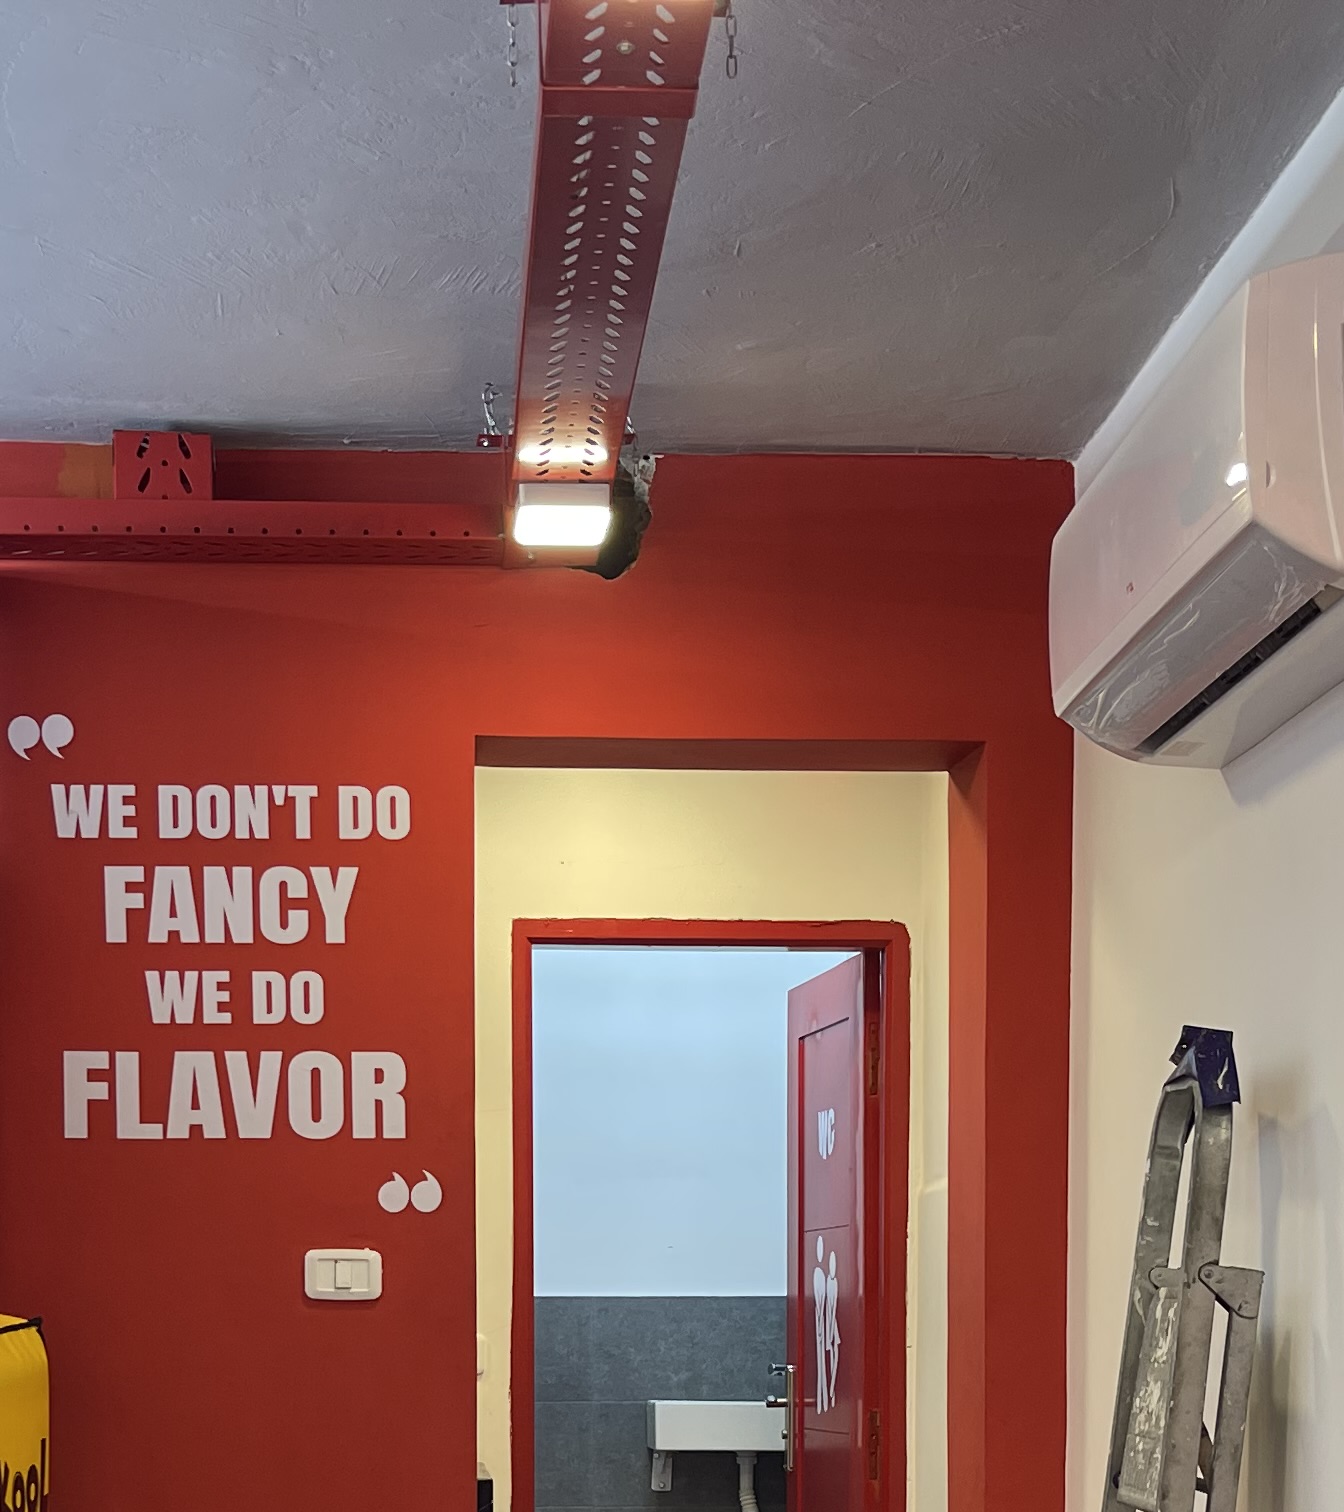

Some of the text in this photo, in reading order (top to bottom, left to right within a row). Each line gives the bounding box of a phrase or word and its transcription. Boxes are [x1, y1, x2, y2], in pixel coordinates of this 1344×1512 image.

[51, 784, 412, 840] WE DON'T DO
[104, 865, 359, 944] FANCY
[145, 970, 325, 1025] WE DO
[63, 1050, 408, 1141] FLAVOR
[817, 1107, 835, 1160] WC
